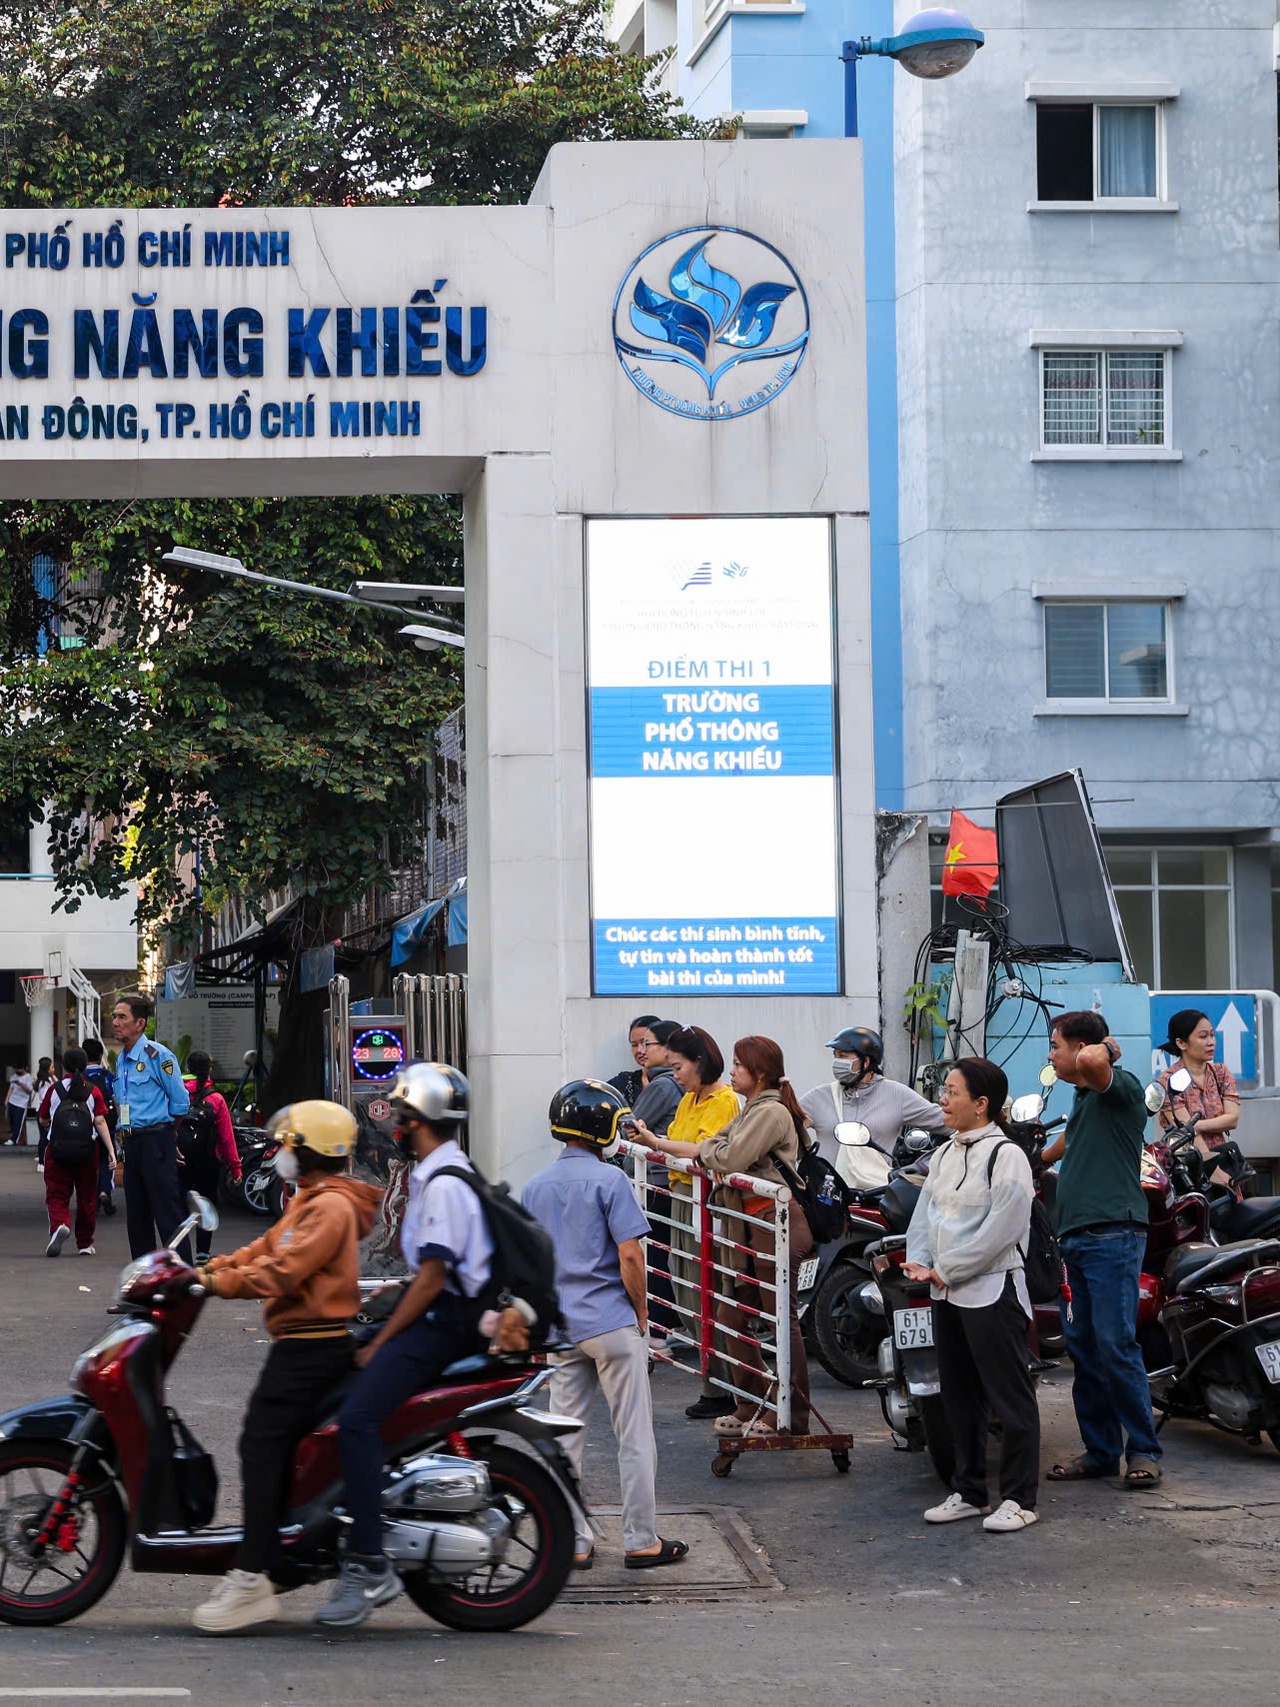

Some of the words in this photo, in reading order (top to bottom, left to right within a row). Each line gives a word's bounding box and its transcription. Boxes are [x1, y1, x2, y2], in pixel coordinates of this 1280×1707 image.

[5, 220, 72, 270] PHỐ
[83, 219, 125, 268] HỒ
[138, 223, 192, 267] CHÍ
[205, 231, 290, 266] MINH
[74, 292, 264, 378] NĂNG
[288, 279, 487, 378] KHIẾU
[42, 396, 150, 443] ĐÔNG,
[210, 390, 251, 440] HỒ
[260, 394, 315, 438] CHÍ
[330, 401, 421, 437] MINH
[648, 653, 708, 679] ĐIỂM
[715, 660, 753, 678] THI
[762, 660, 772, 677] 1
[662, 689, 760, 713] TRƯỜNG
[645, 716, 694, 741] PHỔ
[696, 718, 779, 741] THÔNG
[642, 748, 709, 771] NĂNG
[714, 745, 782, 770] KHIẾU
[605, 926, 648, 943] Chúc
[650, 926, 677, 942] các
[680, 926, 704, 942] thí
[706, 926, 742, 942] sinh
[745, 925, 783, 942] bình
[786, 924, 826, 943] tĩnh,
[619, 949, 638, 968] tự
[639, 949, 665, 964] tin
[666, 948, 687, 964] và
[690, 947, 732, 964] hoàn
[735, 947, 785, 964] thành
[788, 945, 814, 963] tốt
[648, 969, 674, 986] bài
[677, 969, 701, 985] thi
[704, 969, 733, 985] của
[736, 969, 785, 985] mình!
[228, 992, 254, 1000] (CAMPU
